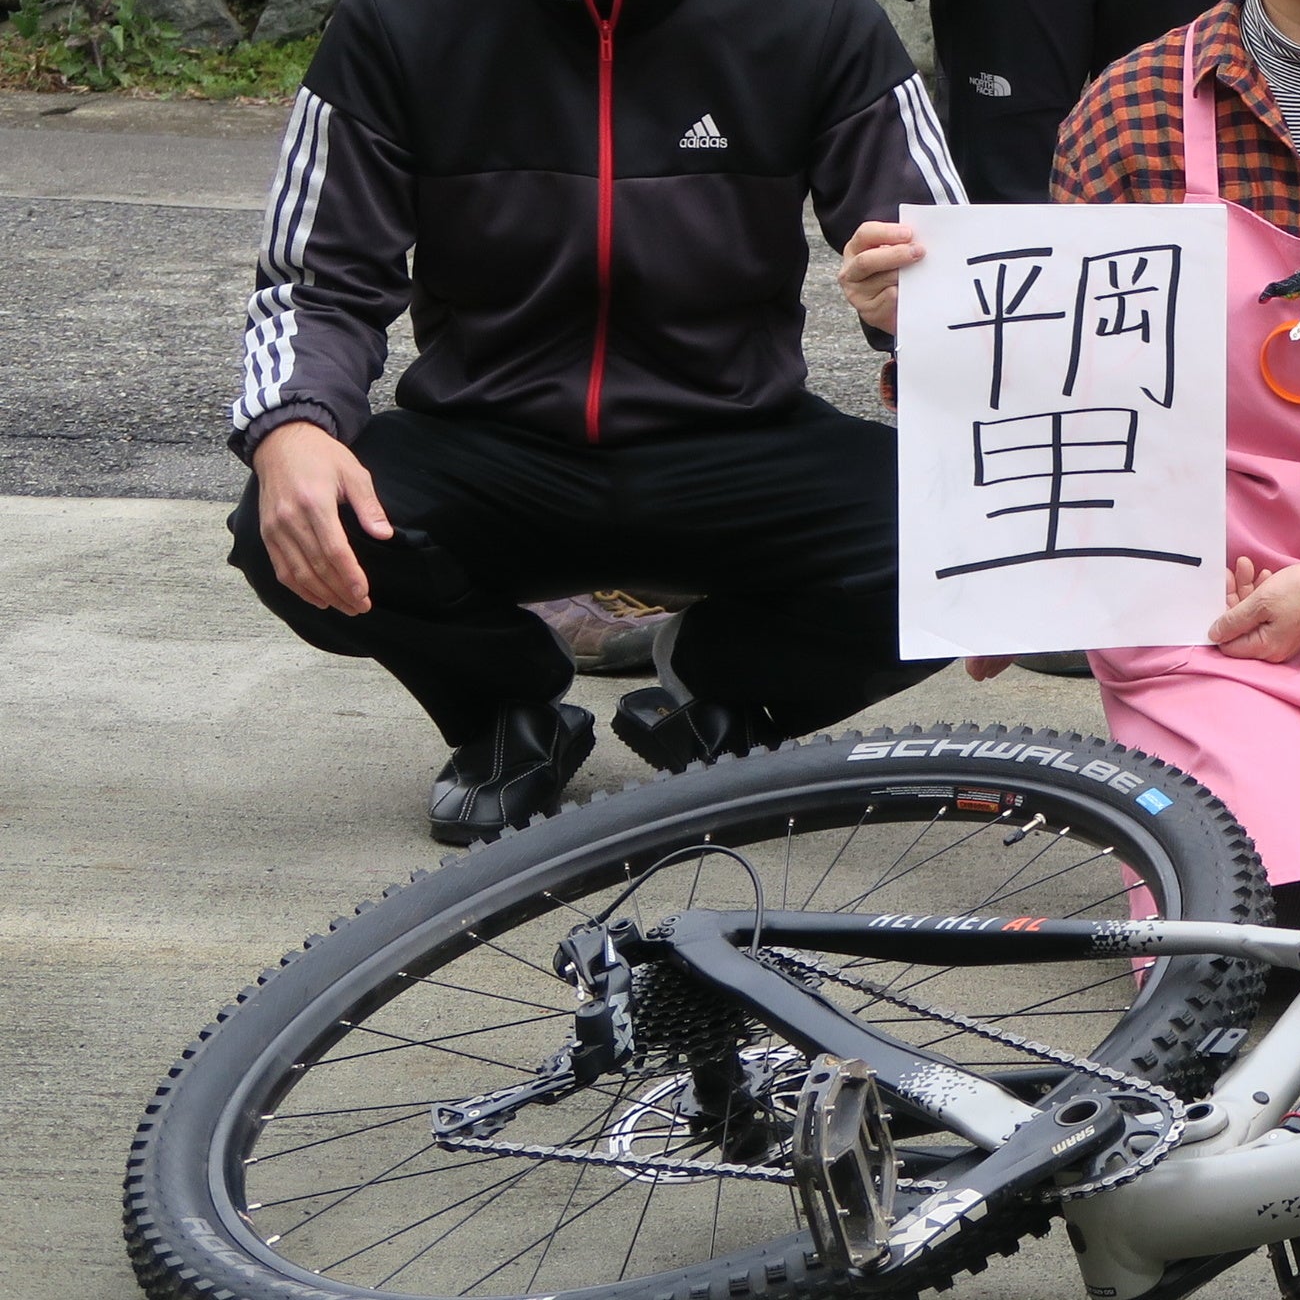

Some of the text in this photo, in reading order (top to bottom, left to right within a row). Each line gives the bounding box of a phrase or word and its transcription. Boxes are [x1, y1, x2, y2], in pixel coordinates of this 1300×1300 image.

[969, 76, 994, 89] NORTH
[980, 72, 993, 81] THE
[976, 85, 994, 97] FACE
[679, 134, 728, 150] adidas
[947, 245, 1182, 410] 平岡
[936, 407, 1202, 579] 里
[846, 738, 1145, 795] SCHWALBE
[1051, 1125, 1096, 1156] SRAM
